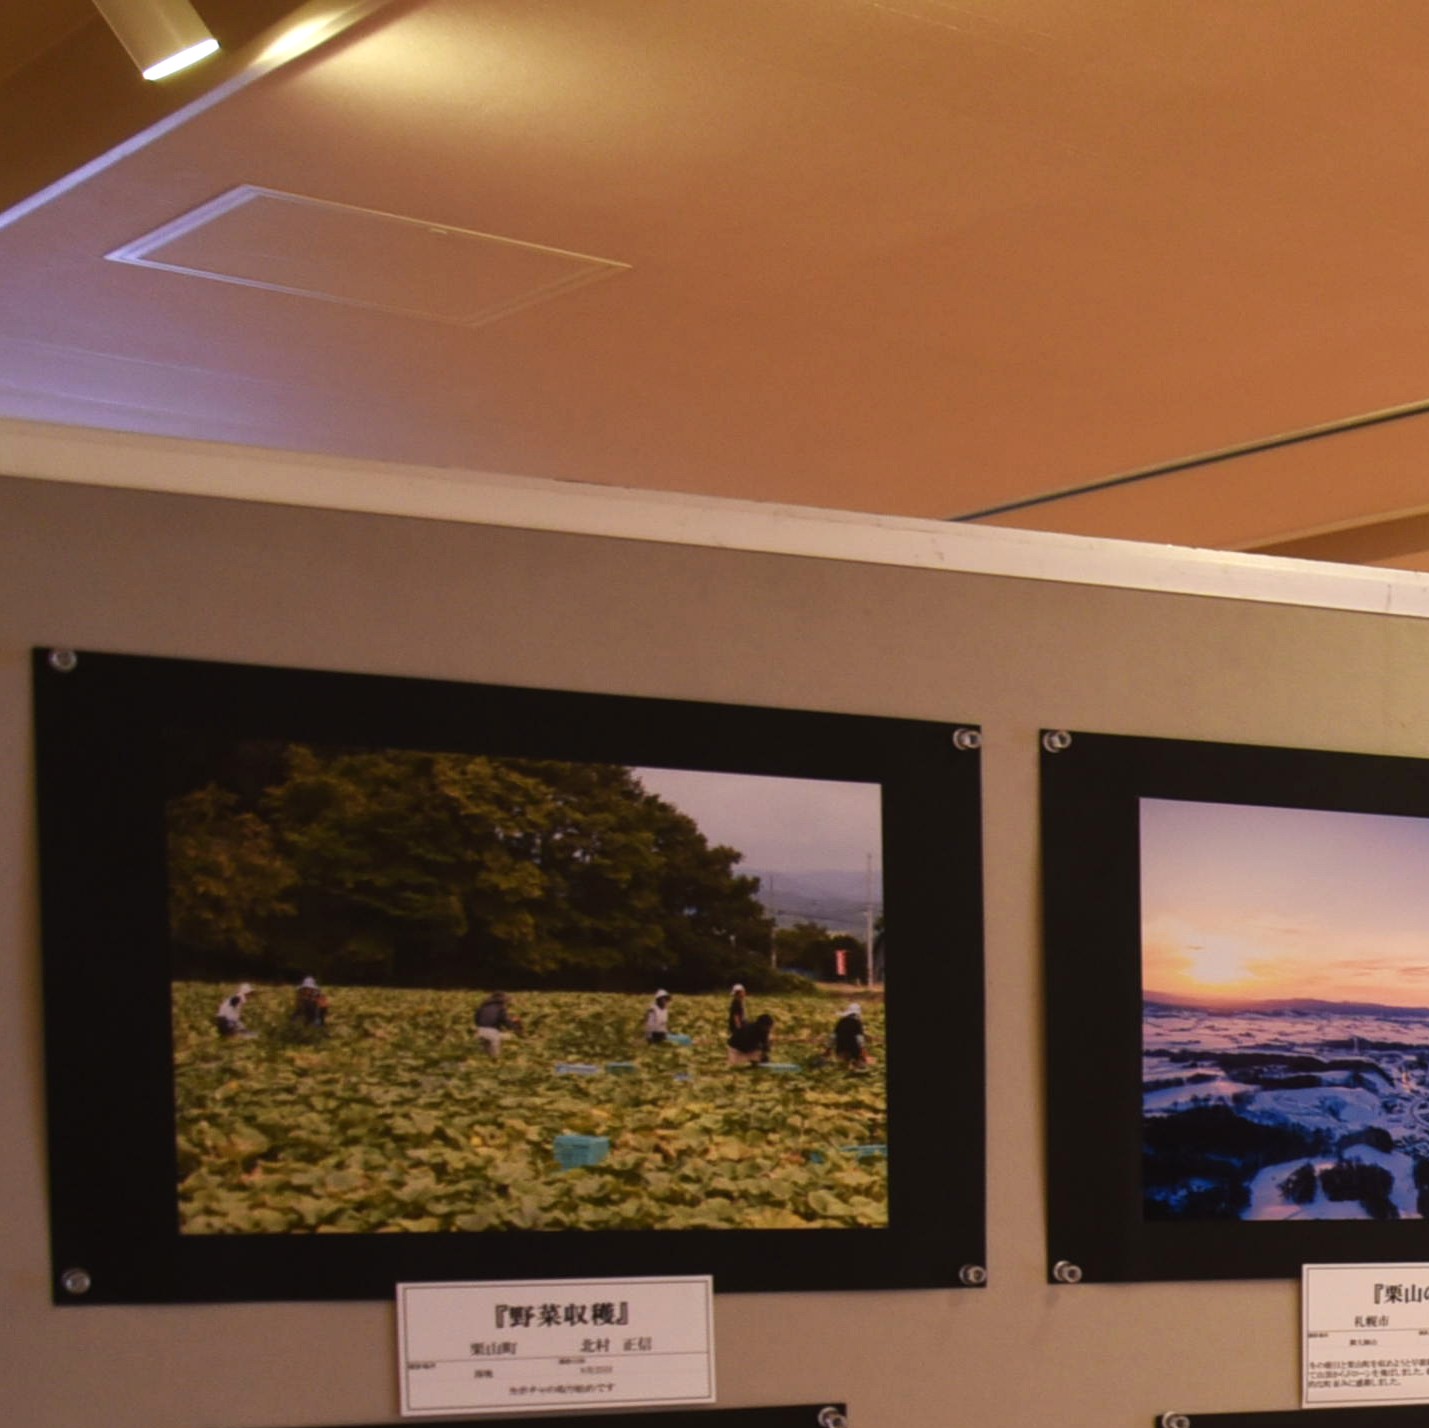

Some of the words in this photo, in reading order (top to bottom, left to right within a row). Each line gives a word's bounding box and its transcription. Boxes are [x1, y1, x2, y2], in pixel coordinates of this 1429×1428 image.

[495, 1301, 629, 1329] 『野菜収穫』
[1354, 1316, 1390, 1328] 札幌市
[470, 1341, 518, 1356] 栗山町
